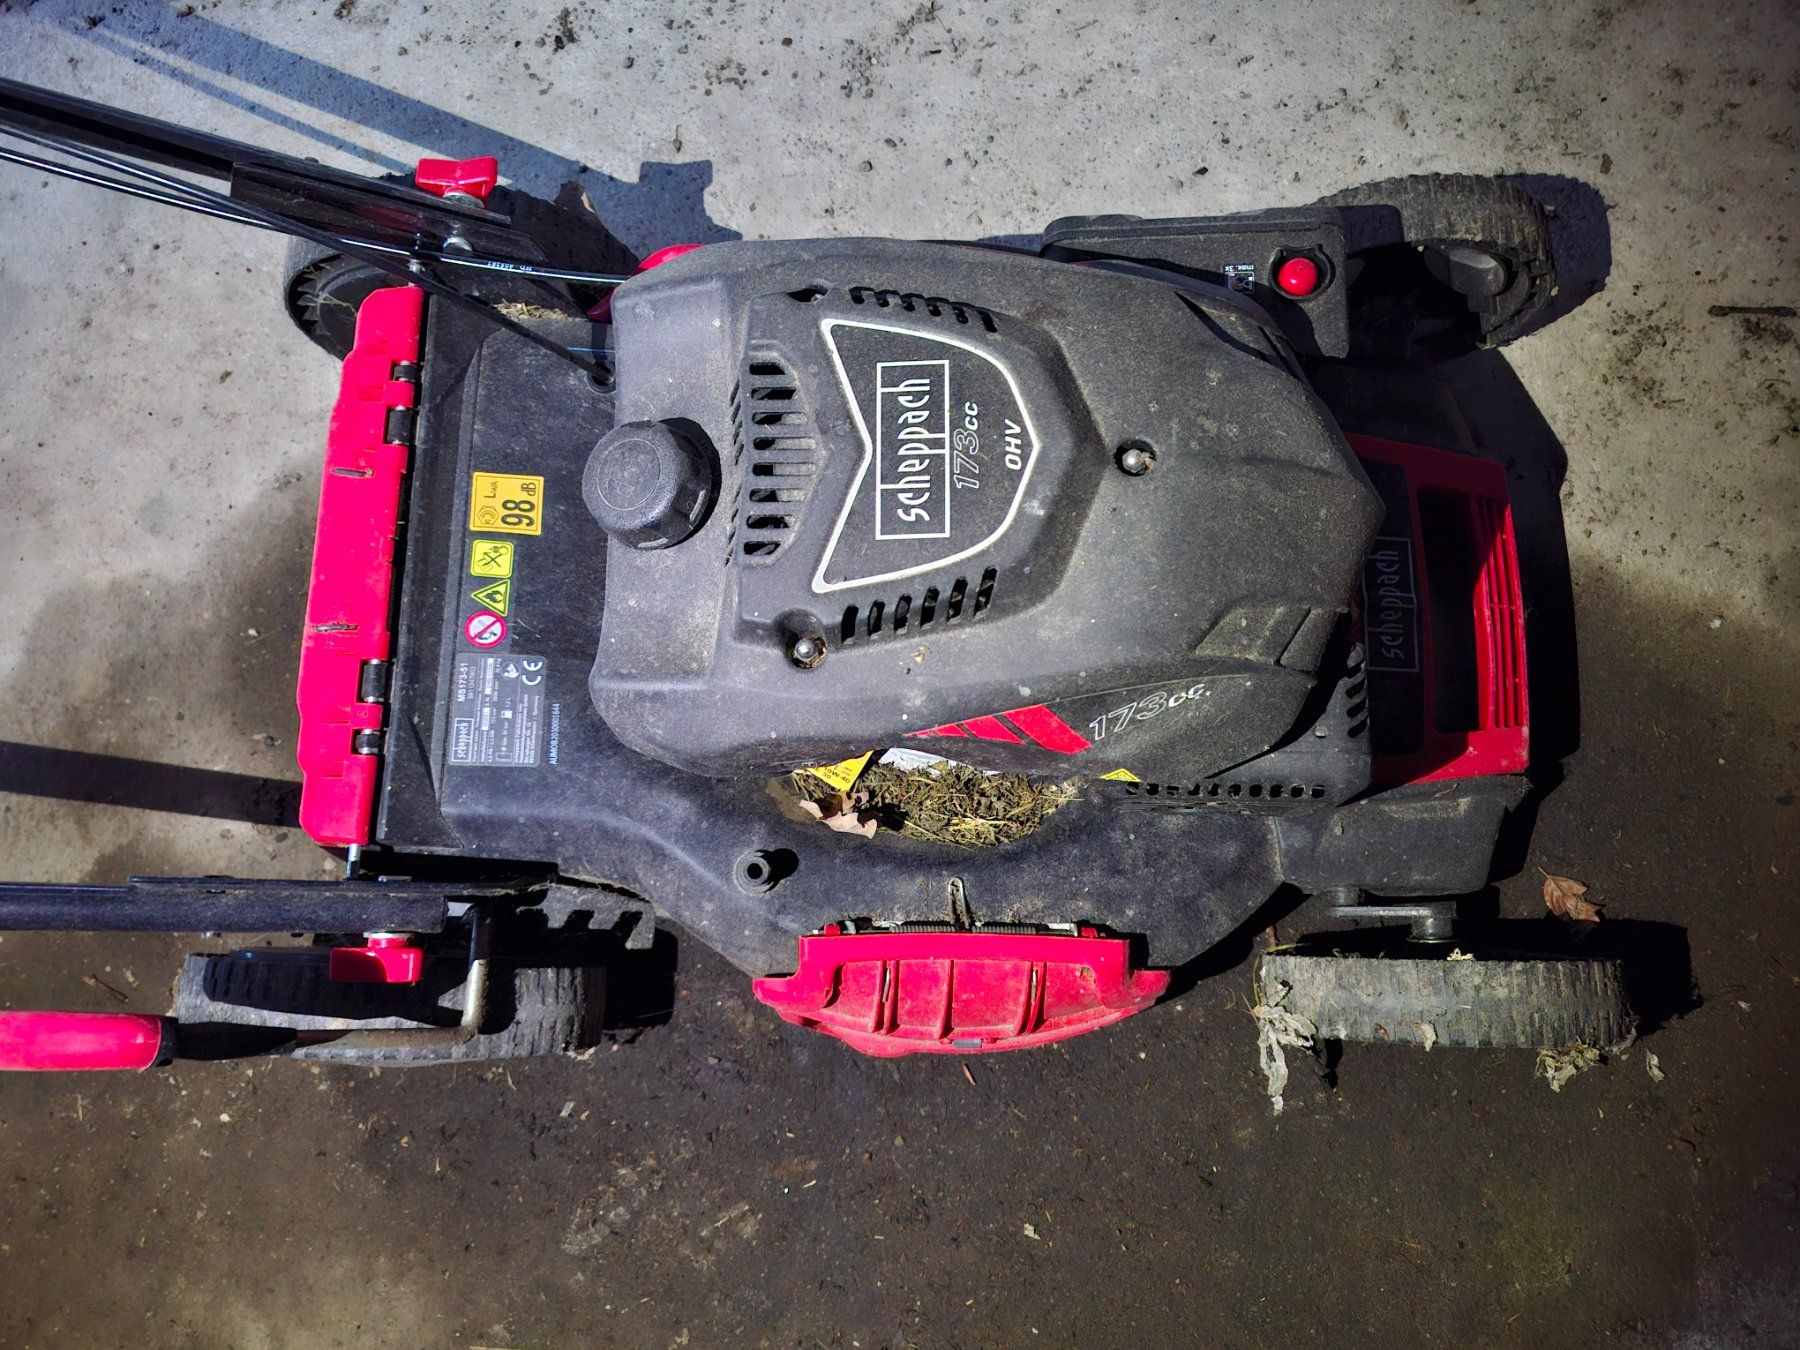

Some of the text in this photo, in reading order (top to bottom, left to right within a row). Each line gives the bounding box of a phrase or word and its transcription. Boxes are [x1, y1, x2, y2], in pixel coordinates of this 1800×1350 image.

[880, 378, 947, 522] scheppach
[954, 402, 979, 489] 173cc
[1005, 418, 1022, 470] OHV
[501, 482, 537, 527] 98 dB
[1367, 551, 1415, 659] scheppach
[457, 662, 469, 702] MS173-51
[522, 661, 543, 686] CE
[455, 721, 472, 758] scheppach
